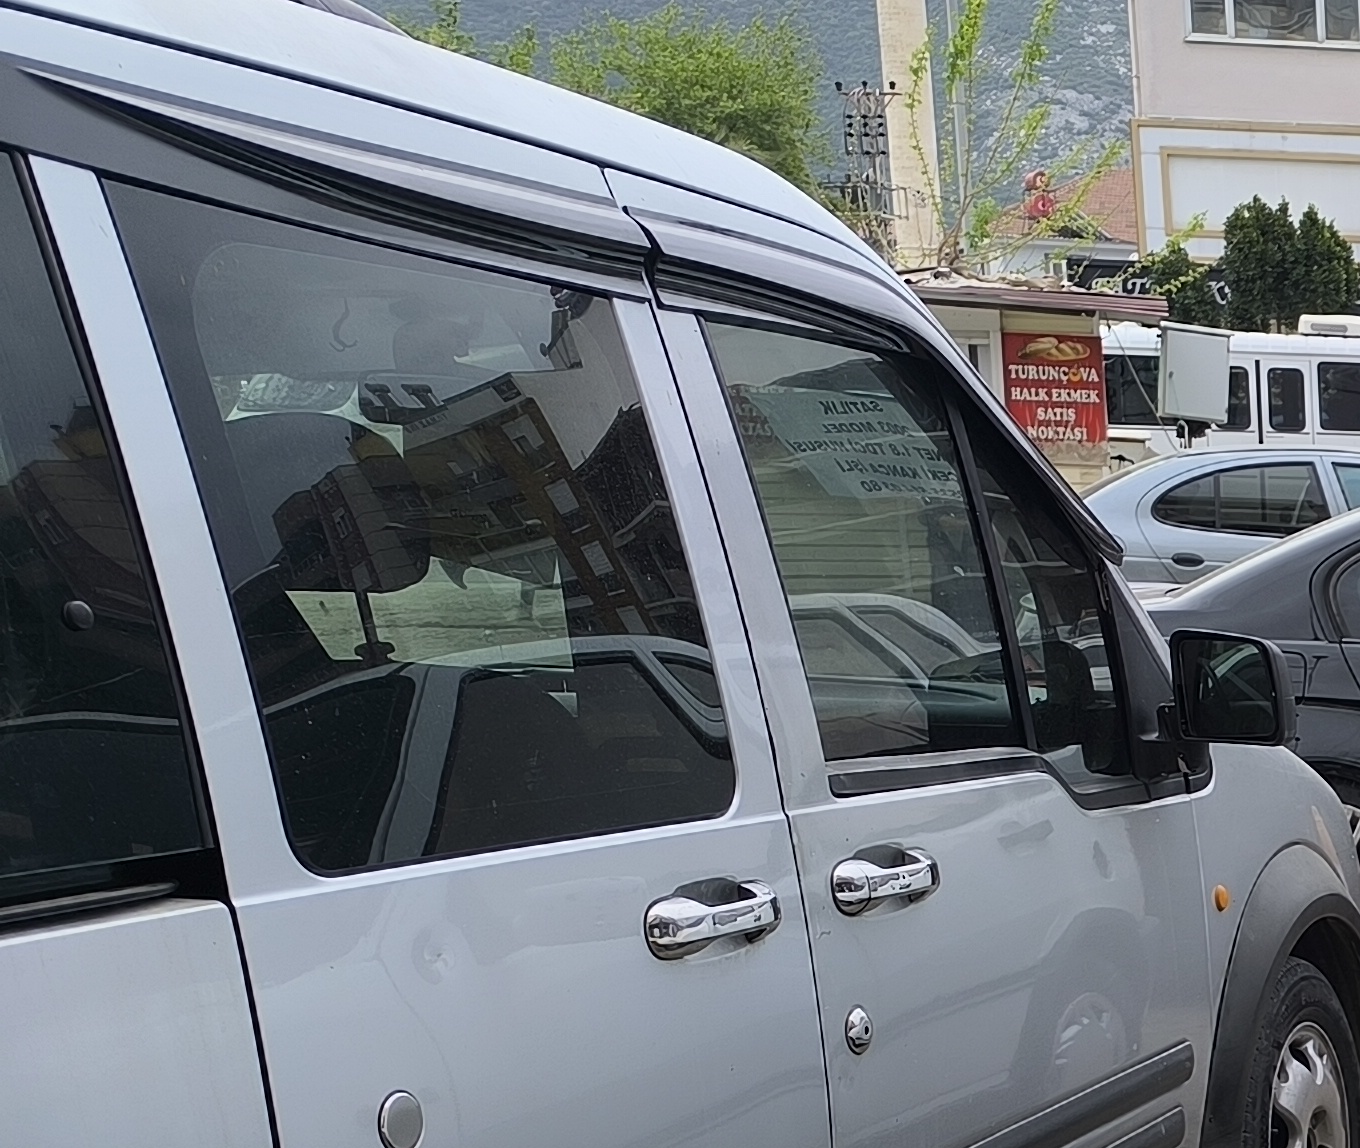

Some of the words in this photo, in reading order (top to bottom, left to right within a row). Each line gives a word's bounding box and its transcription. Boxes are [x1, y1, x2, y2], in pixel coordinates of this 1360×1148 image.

[1008, 364, 1099, 384] TURUNÇOVA
[1010, 386, 1049, 401] HALK
[1051, 388, 1100, 403] EKMEK
[1036, 407, 1076, 424] SATIŞ
[1027, 425, 1087, 440] NOKTASI
